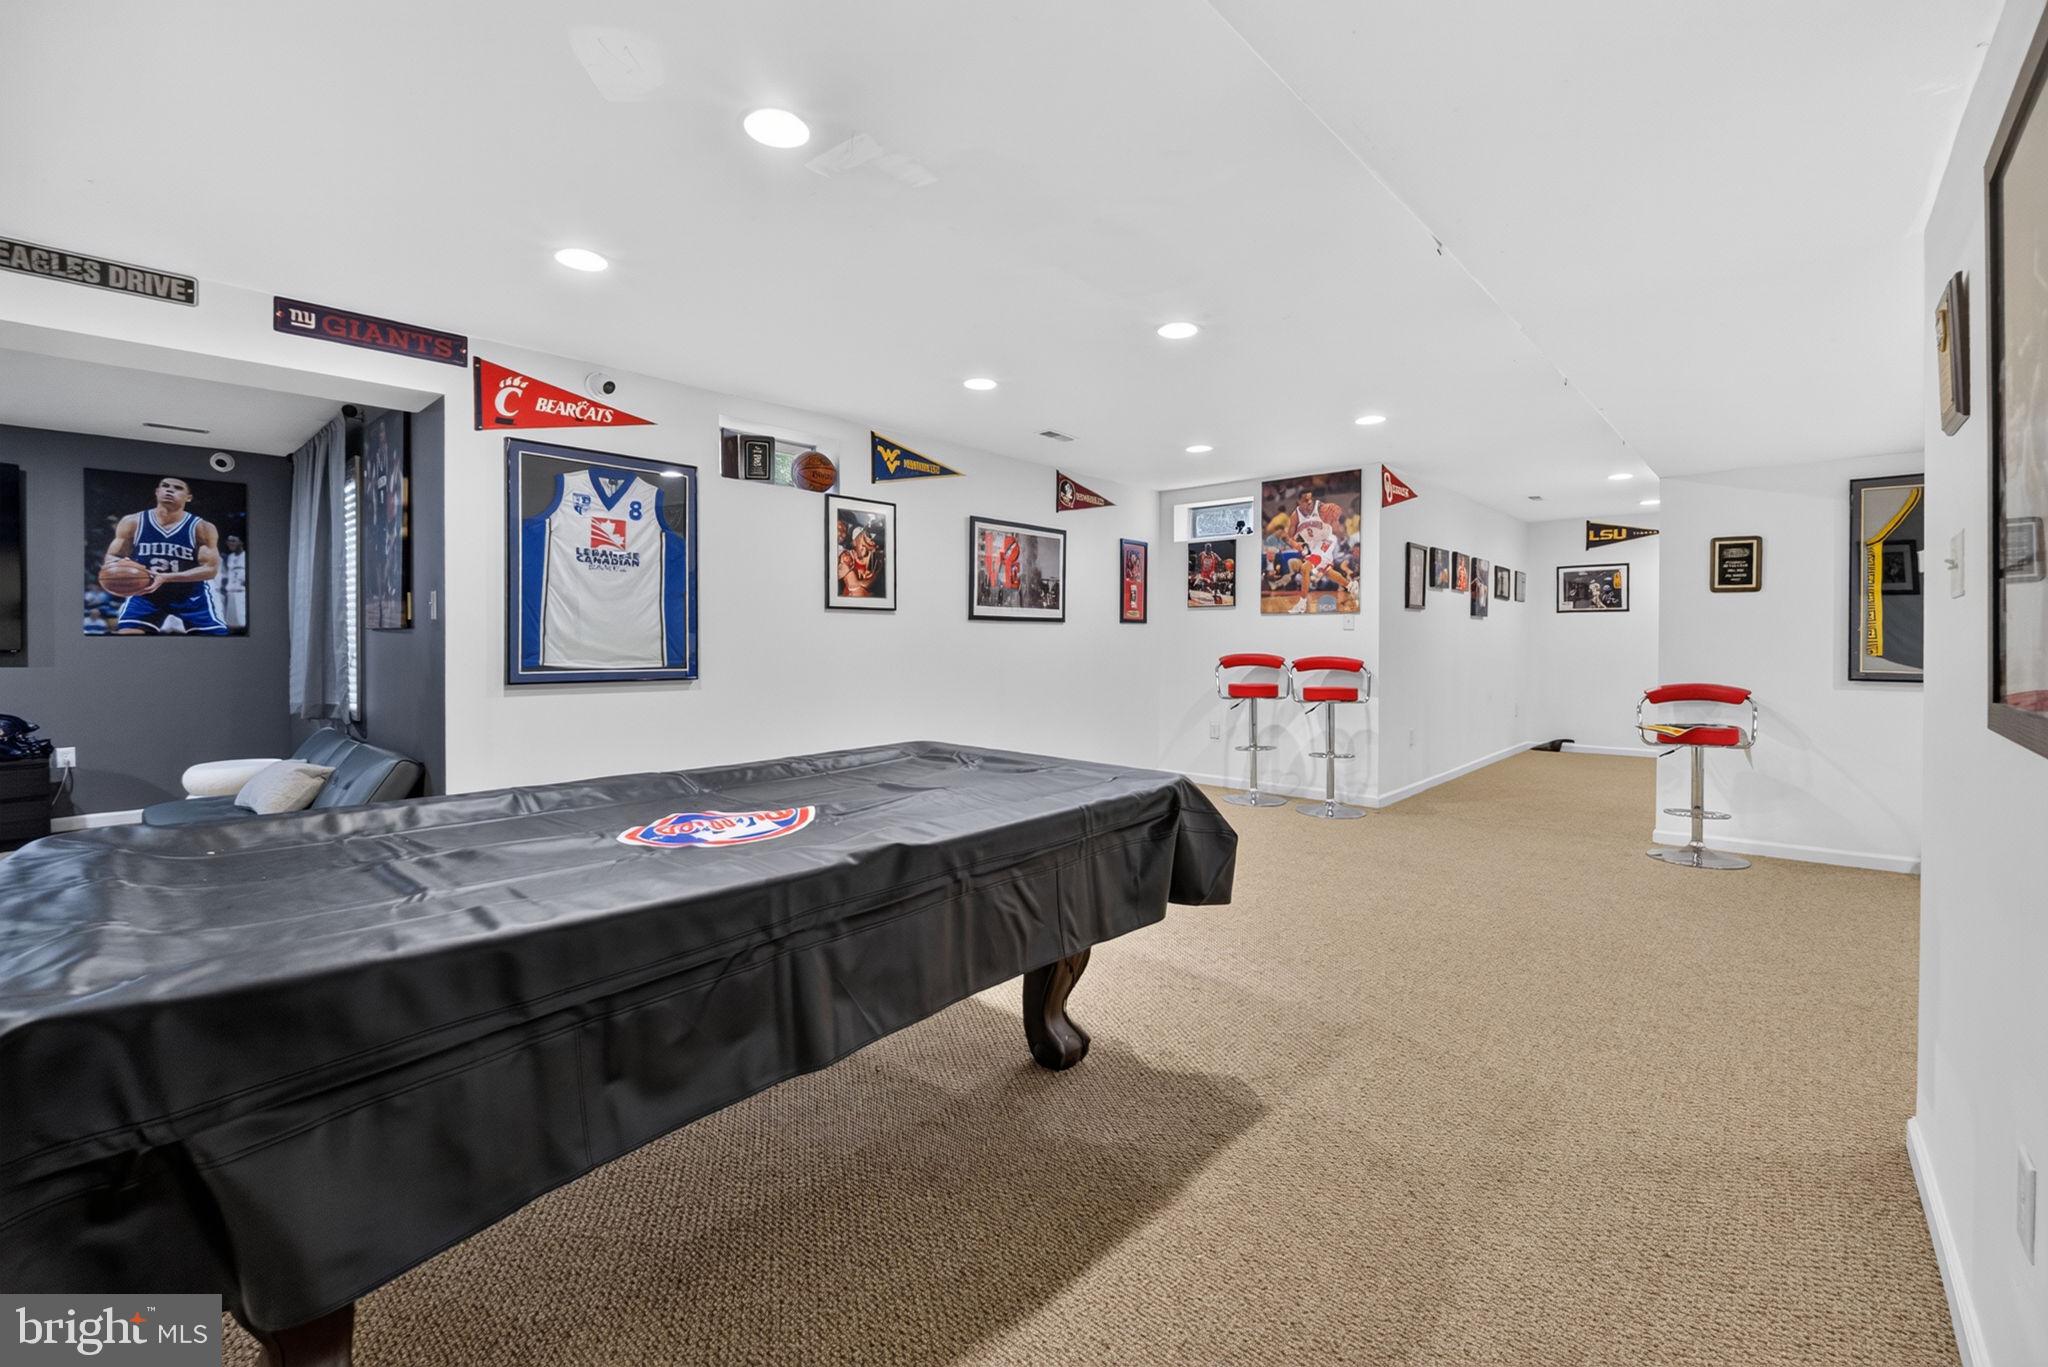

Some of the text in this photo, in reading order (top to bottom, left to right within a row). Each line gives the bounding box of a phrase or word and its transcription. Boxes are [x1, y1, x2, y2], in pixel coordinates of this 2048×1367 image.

[0, 241, 187, 301] EAGLES DRIVE
[322, 314, 453, 359] GIANTS
[535, 396, 614, 424] BEARCATS
[629, 500, 643, 521] 8
[1588, 527, 1628, 542] LSU
[138, 541, 195, 561] DUKE
[575, 554, 641, 568] CANADIAN
[149, 557, 180, 574] 21
